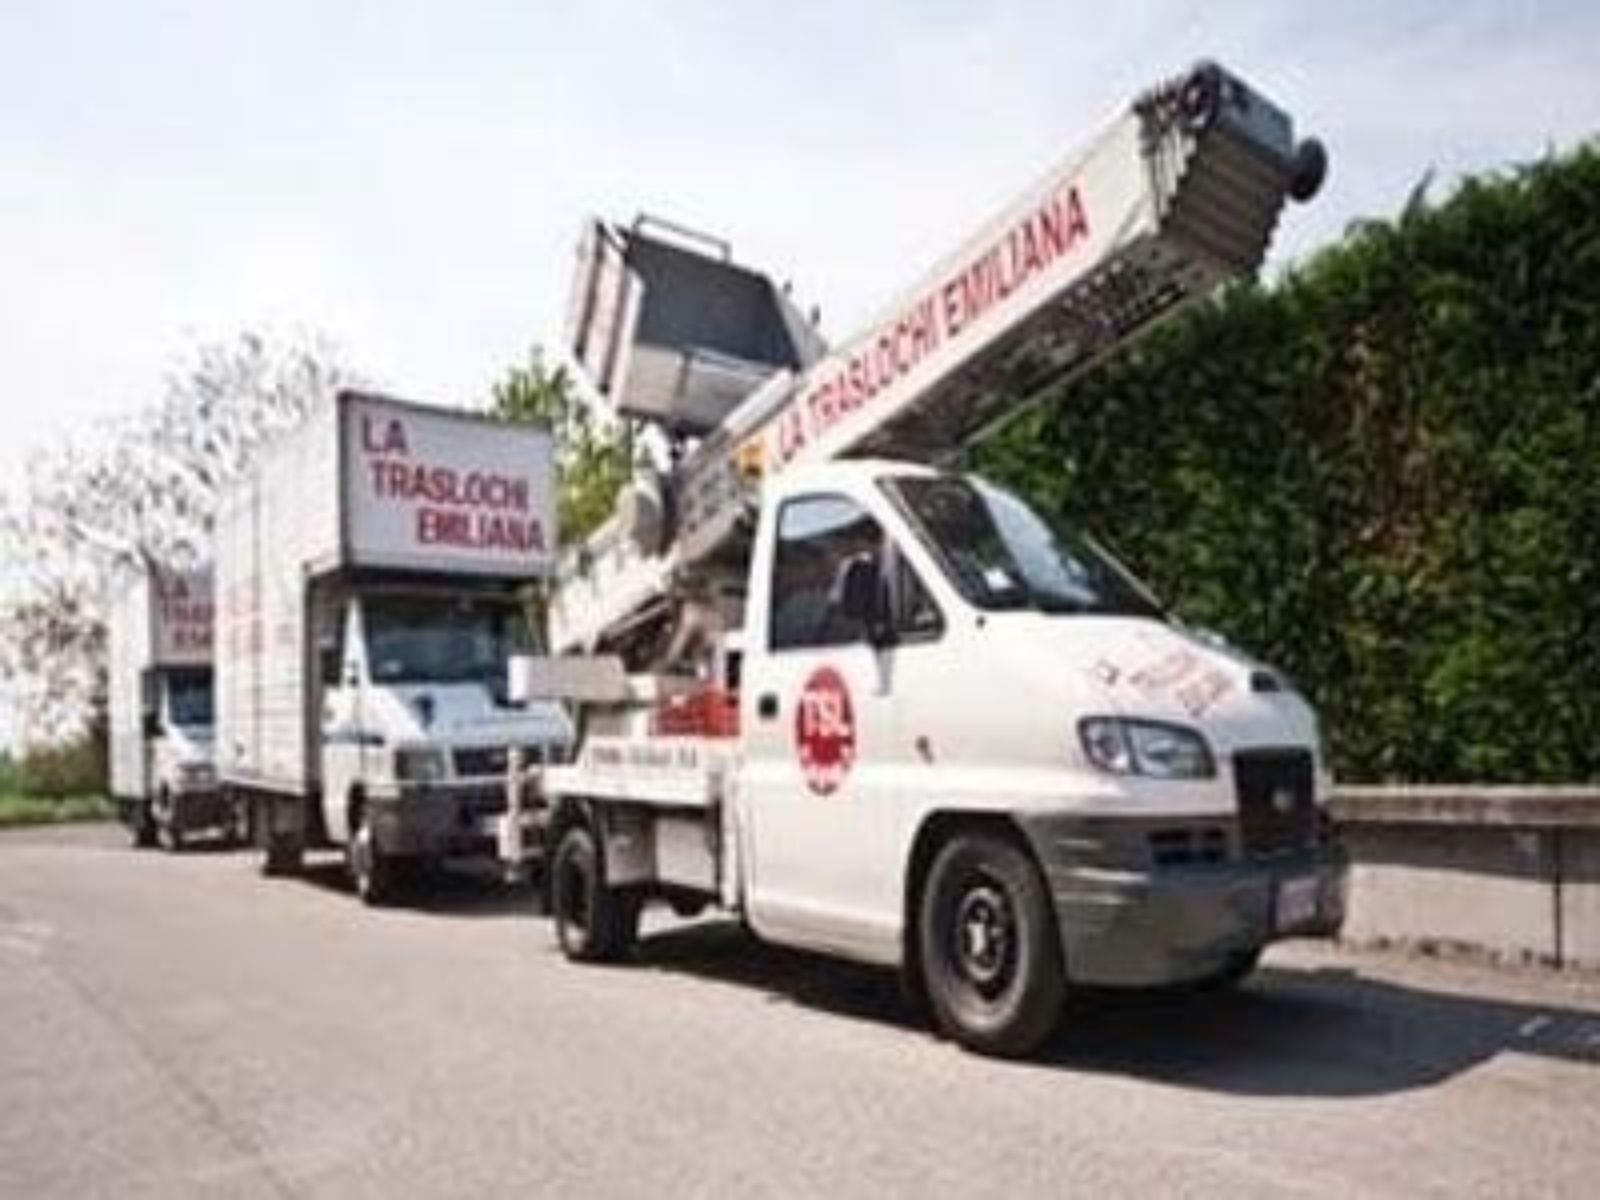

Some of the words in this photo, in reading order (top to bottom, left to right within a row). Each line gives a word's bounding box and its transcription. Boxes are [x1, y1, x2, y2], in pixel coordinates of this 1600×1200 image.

[943, 184, 1090, 338] EMILIANA
[361, 415, 407, 456] LA
[370, 459, 530, 512] TRASLOCHI
[416, 508, 546, 553] EMILIANA
